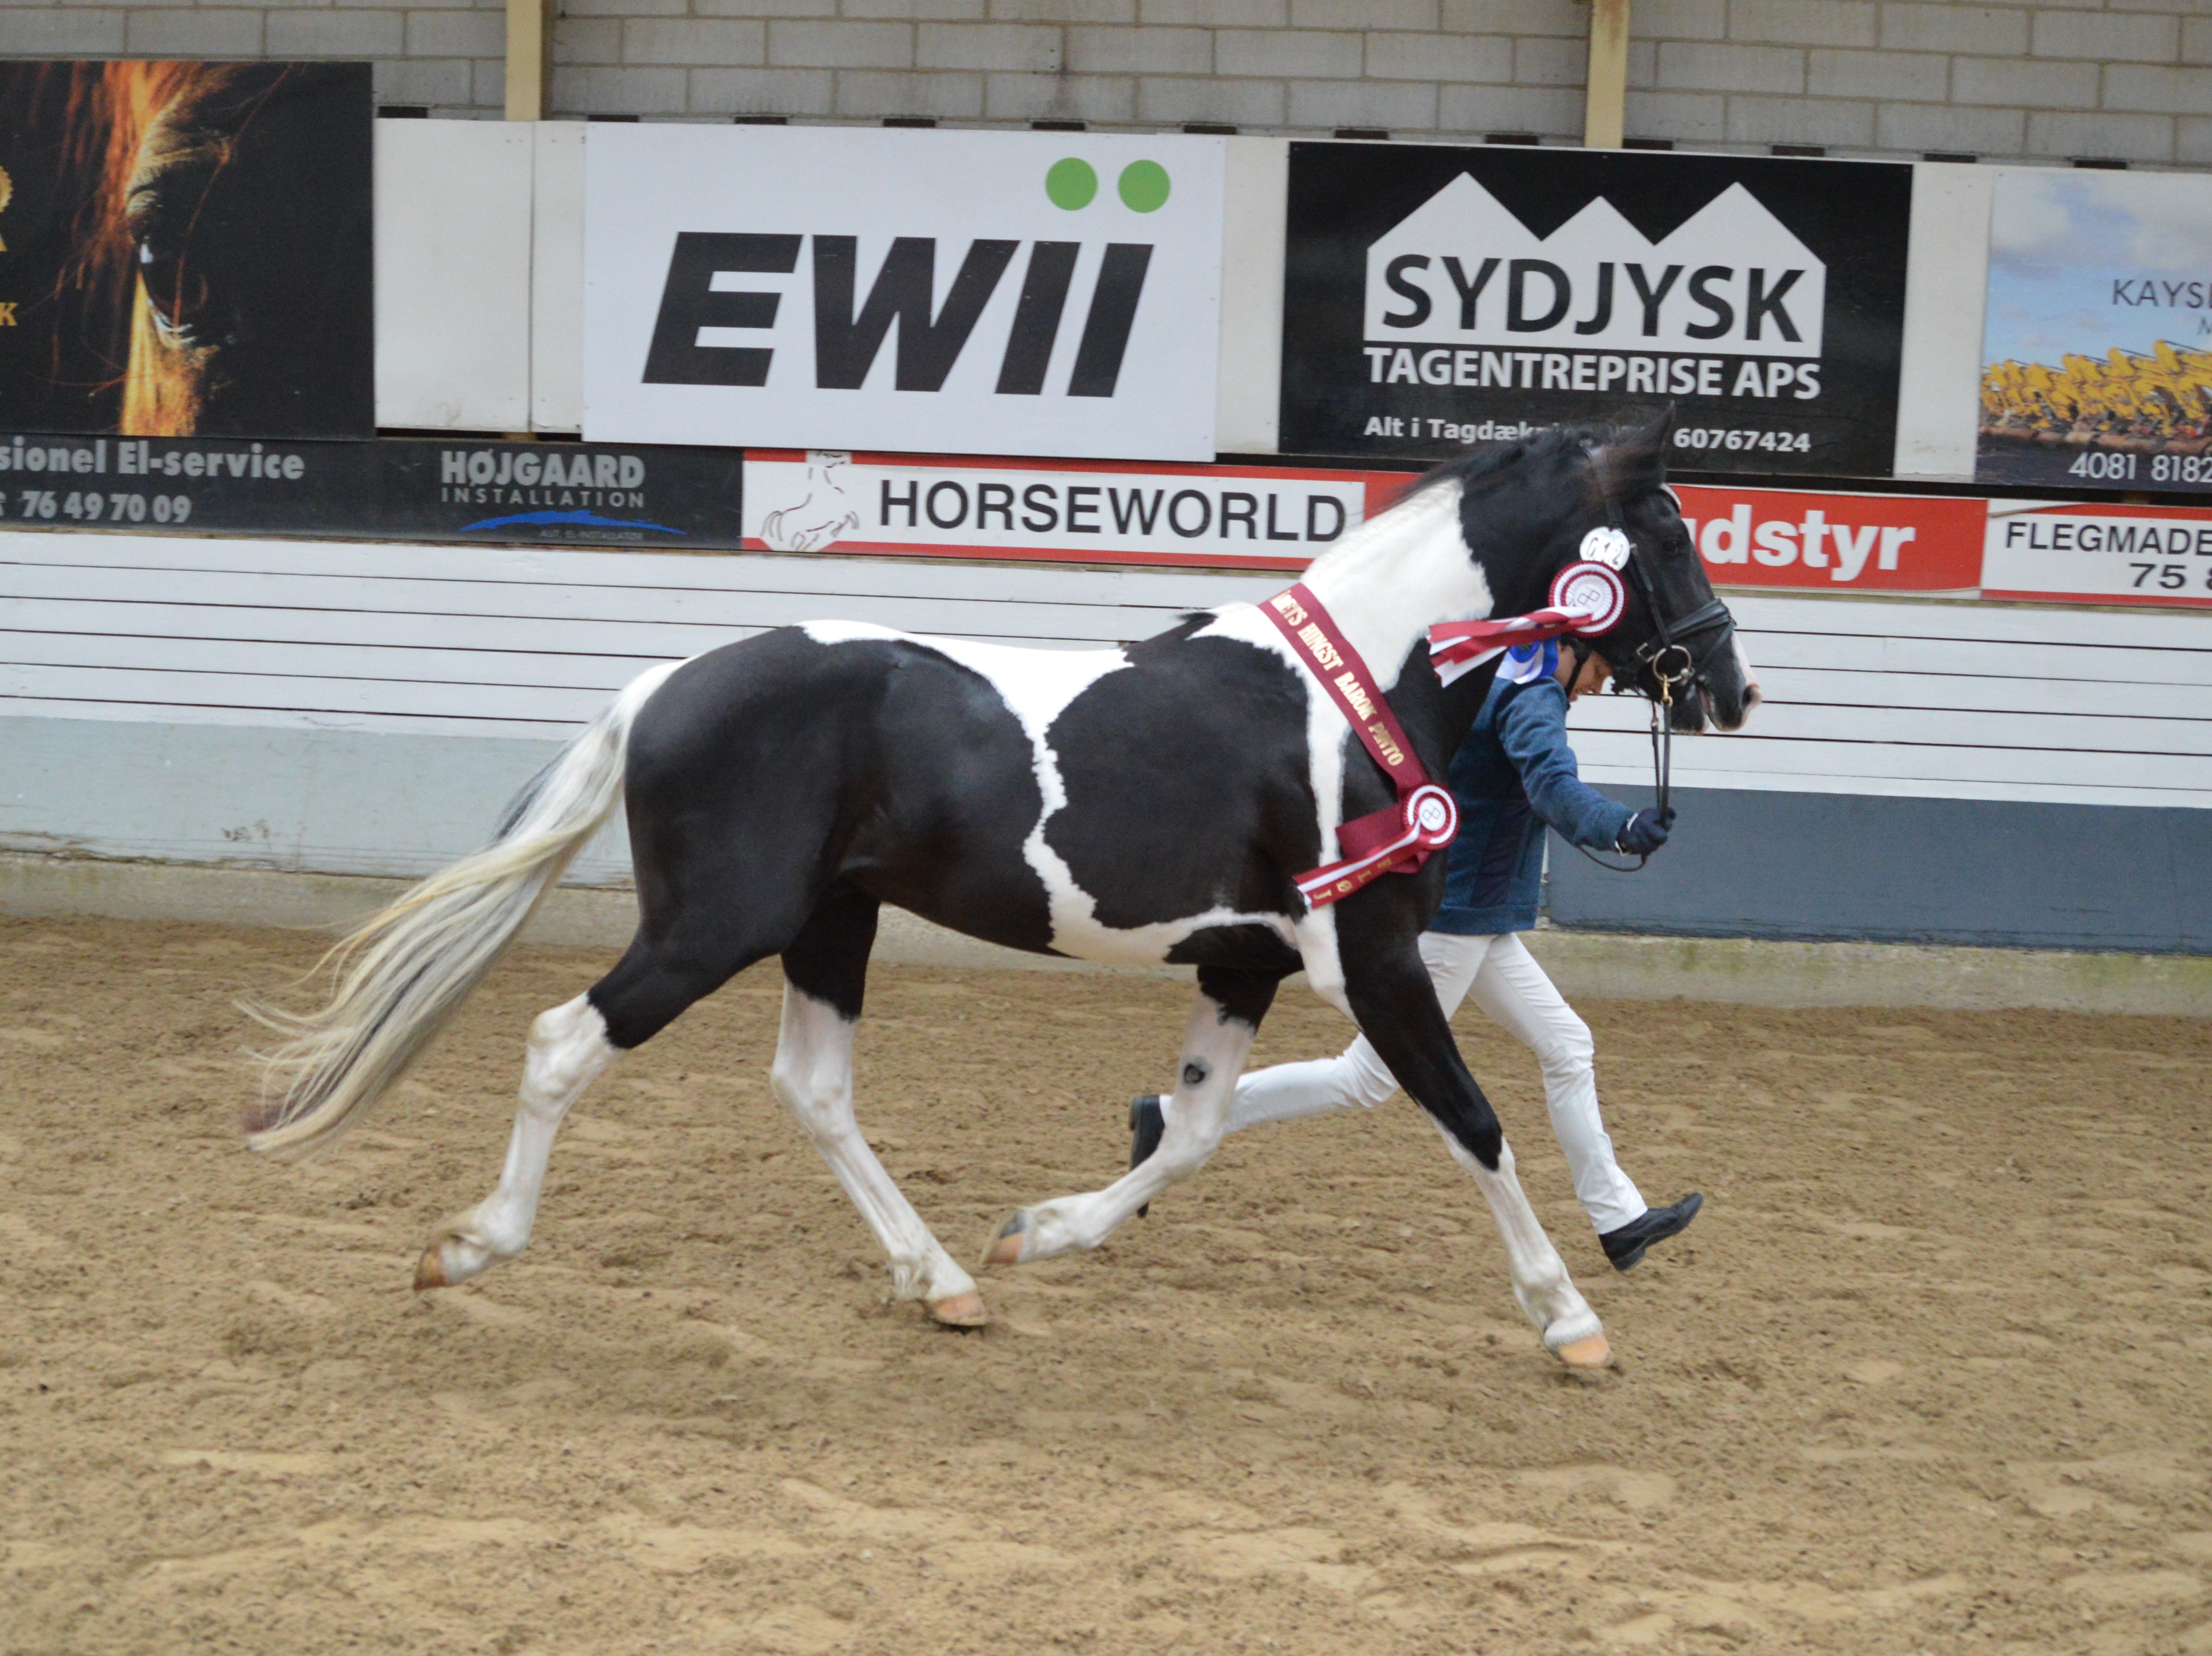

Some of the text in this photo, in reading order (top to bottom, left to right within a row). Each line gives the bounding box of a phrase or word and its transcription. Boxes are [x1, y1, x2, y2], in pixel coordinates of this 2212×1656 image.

[1382, 254, 1806, 342] SYDJYSK
[1363, 347, 1822, 400] TAGENTREPRISE APS
[1364, 416, 1405, 437] Alt
[1411, 417, 1419, 437] i
[1673, 428, 1811, 453] 60767424
[117, 440, 305, 480] El-service
[442, 449, 646, 489] HØJGAARD
[2068, 452, 2212, 483] 4081 8182
[22, 490, 192, 524] 76 49 70 09
[442, 488, 644, 508] INSTALLATION
[880, 480, 1347, 543] HORSEWORLD
[2006, 522, 2212, 556] FLEGMADE
[2129, 563, 2187, 589] 75
[1297, 622, 1344, 671] HINGST
[1334, 671, 1377, 721] BAROK
